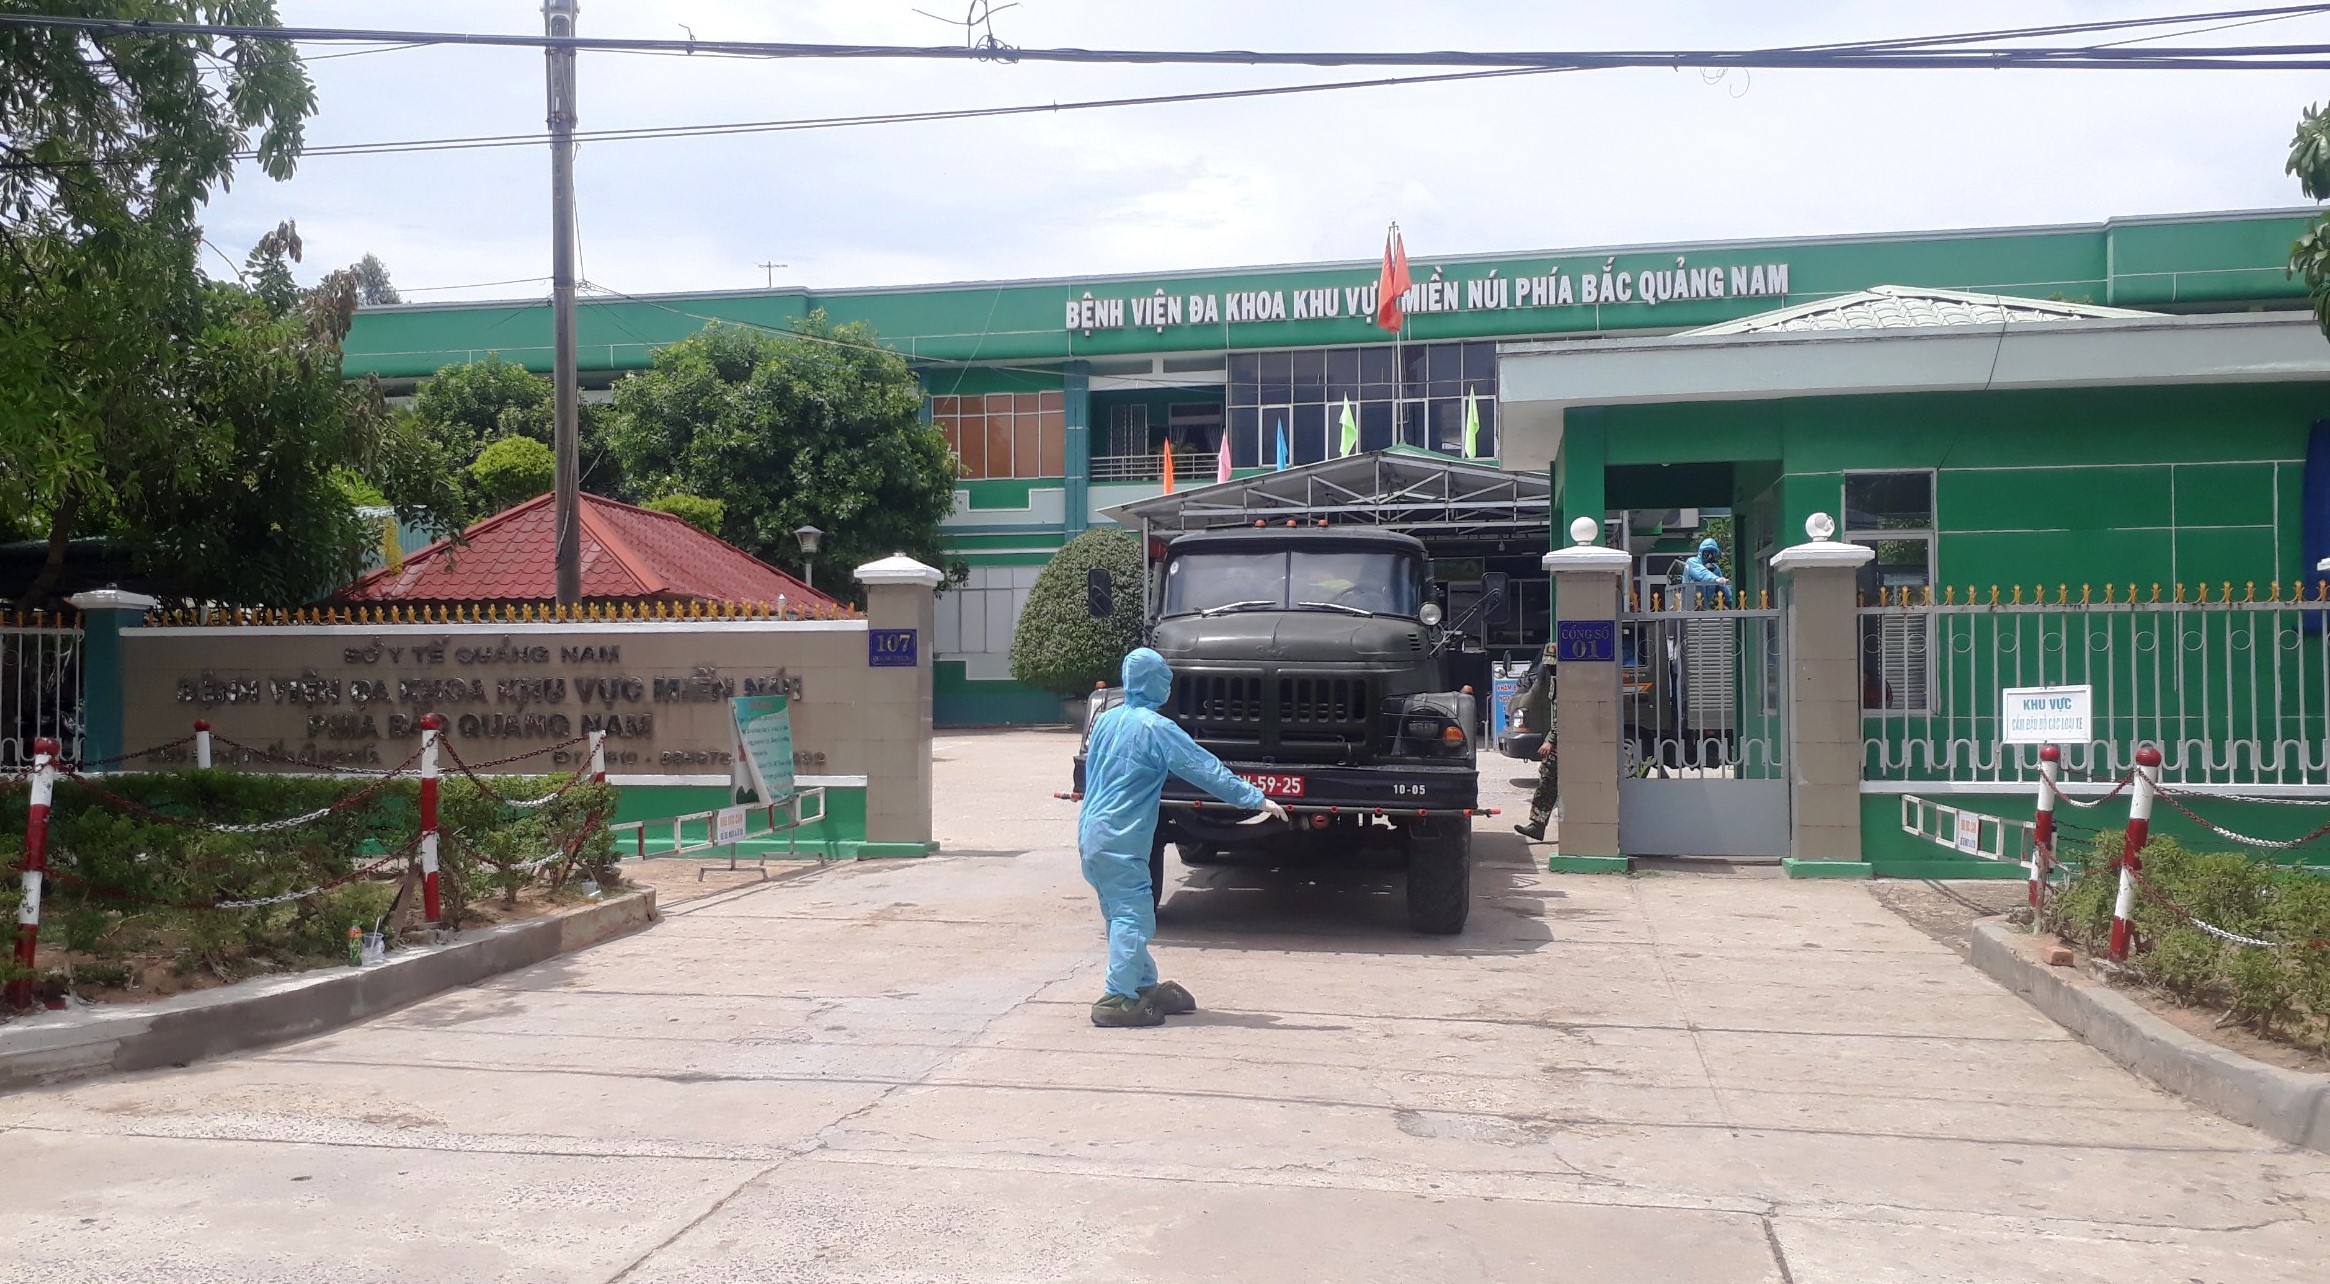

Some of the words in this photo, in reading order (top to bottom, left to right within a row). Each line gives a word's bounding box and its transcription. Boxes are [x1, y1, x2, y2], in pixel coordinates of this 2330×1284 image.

[1065, 291, 1124, 337] BỆNH
[1130, 287, 1183, 334] VIỆN
[1188, 294, 1219, 324] ĐA
[1225, 290, 1287, 321] KHOA
[1293, 287, 1340, 319] KHU
[1345, 280, 1378, 325] VỰ
[1401, 265, 1460, 314] MIỀN
[1467, 269, 1508, 309] NÚI
[1515, 266, 1574, 306] PHÍA
[1581, 256, 1632, 303] BẮC
[1639, 256, 1725, 305] QUẢNG
[1731, 264, 1789, 296] NAM
[877, 634, 911, 652] 107
[1572, 640, 1600, 658] 01
[387, 646, 405, 664] Y
[560, 644, 621, 664] NAM
[2023, 699, 2046, 711] KHU
[2049, 696, 2072, 713] VỰC
[1239, 775, 1302, 794] V-59-25
[1393, 784, 1426, 795] 10-05
